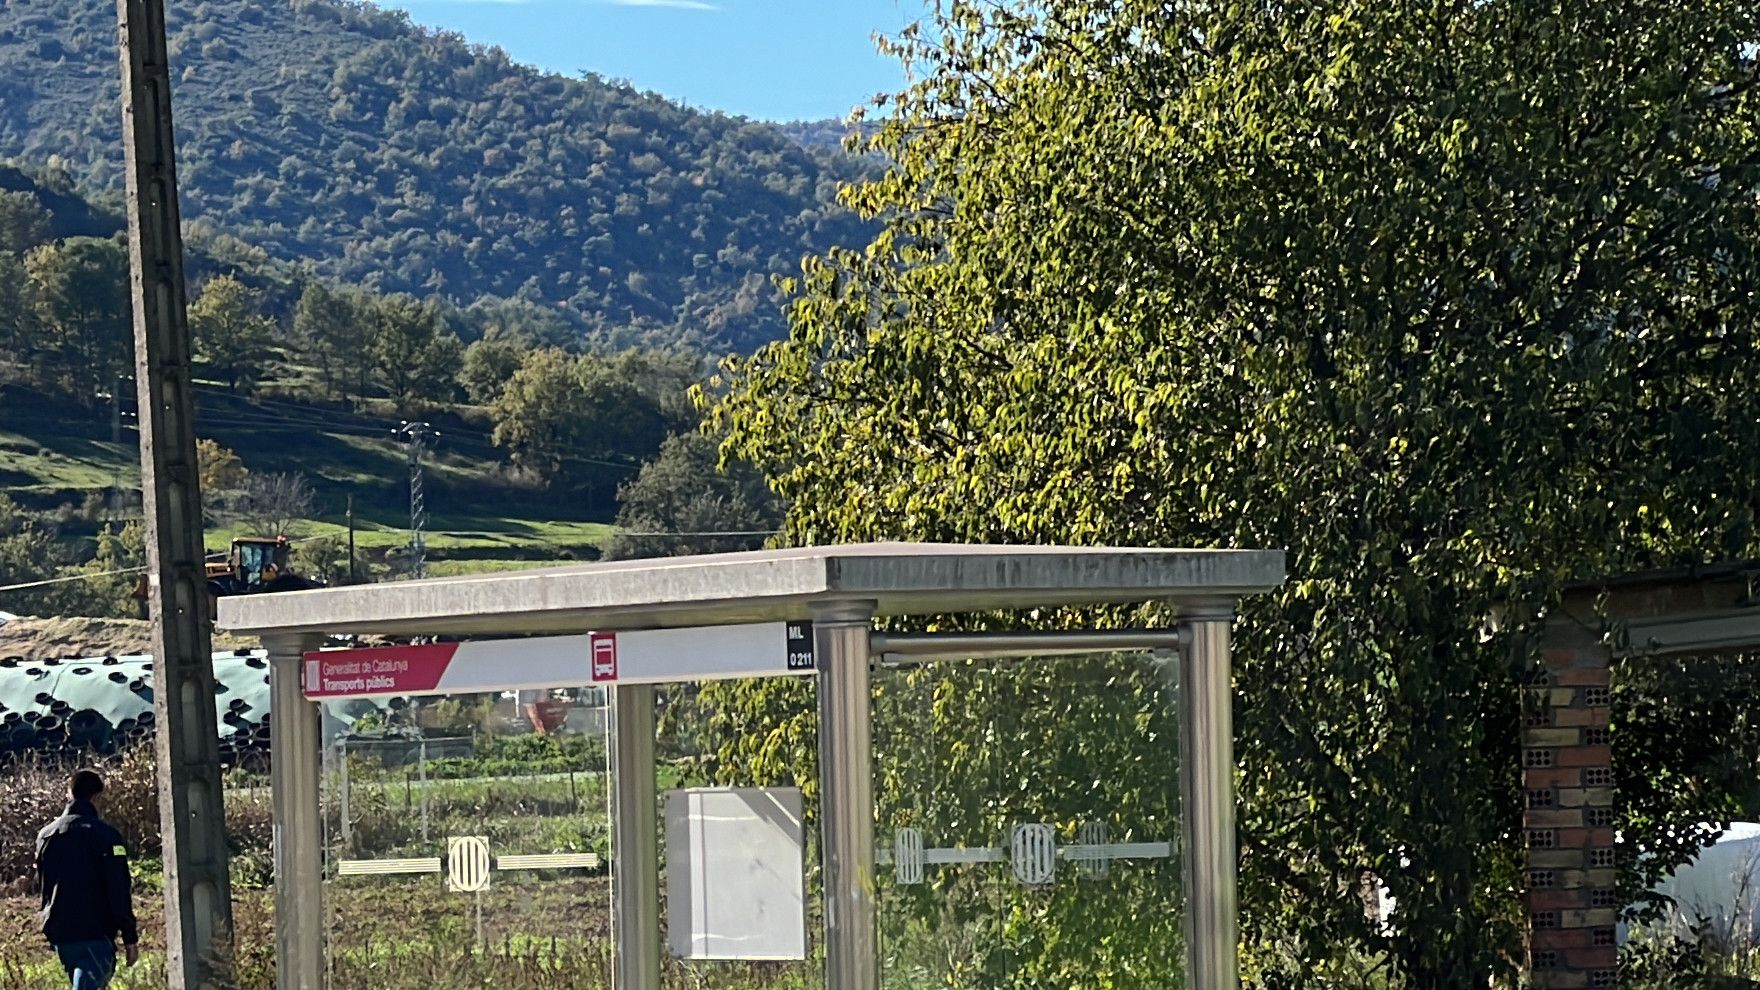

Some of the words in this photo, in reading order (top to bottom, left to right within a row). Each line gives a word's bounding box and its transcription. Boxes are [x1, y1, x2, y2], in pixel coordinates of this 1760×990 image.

[789, 626, 804, 639] ML
[323, 661, 360, 676] Generalitat
[362, 662, 371, 673] de
[372, 659, 408, 673] Catalunya
[323, 677, 365, 692] Transports
[366, 675, 395, 691] públics
